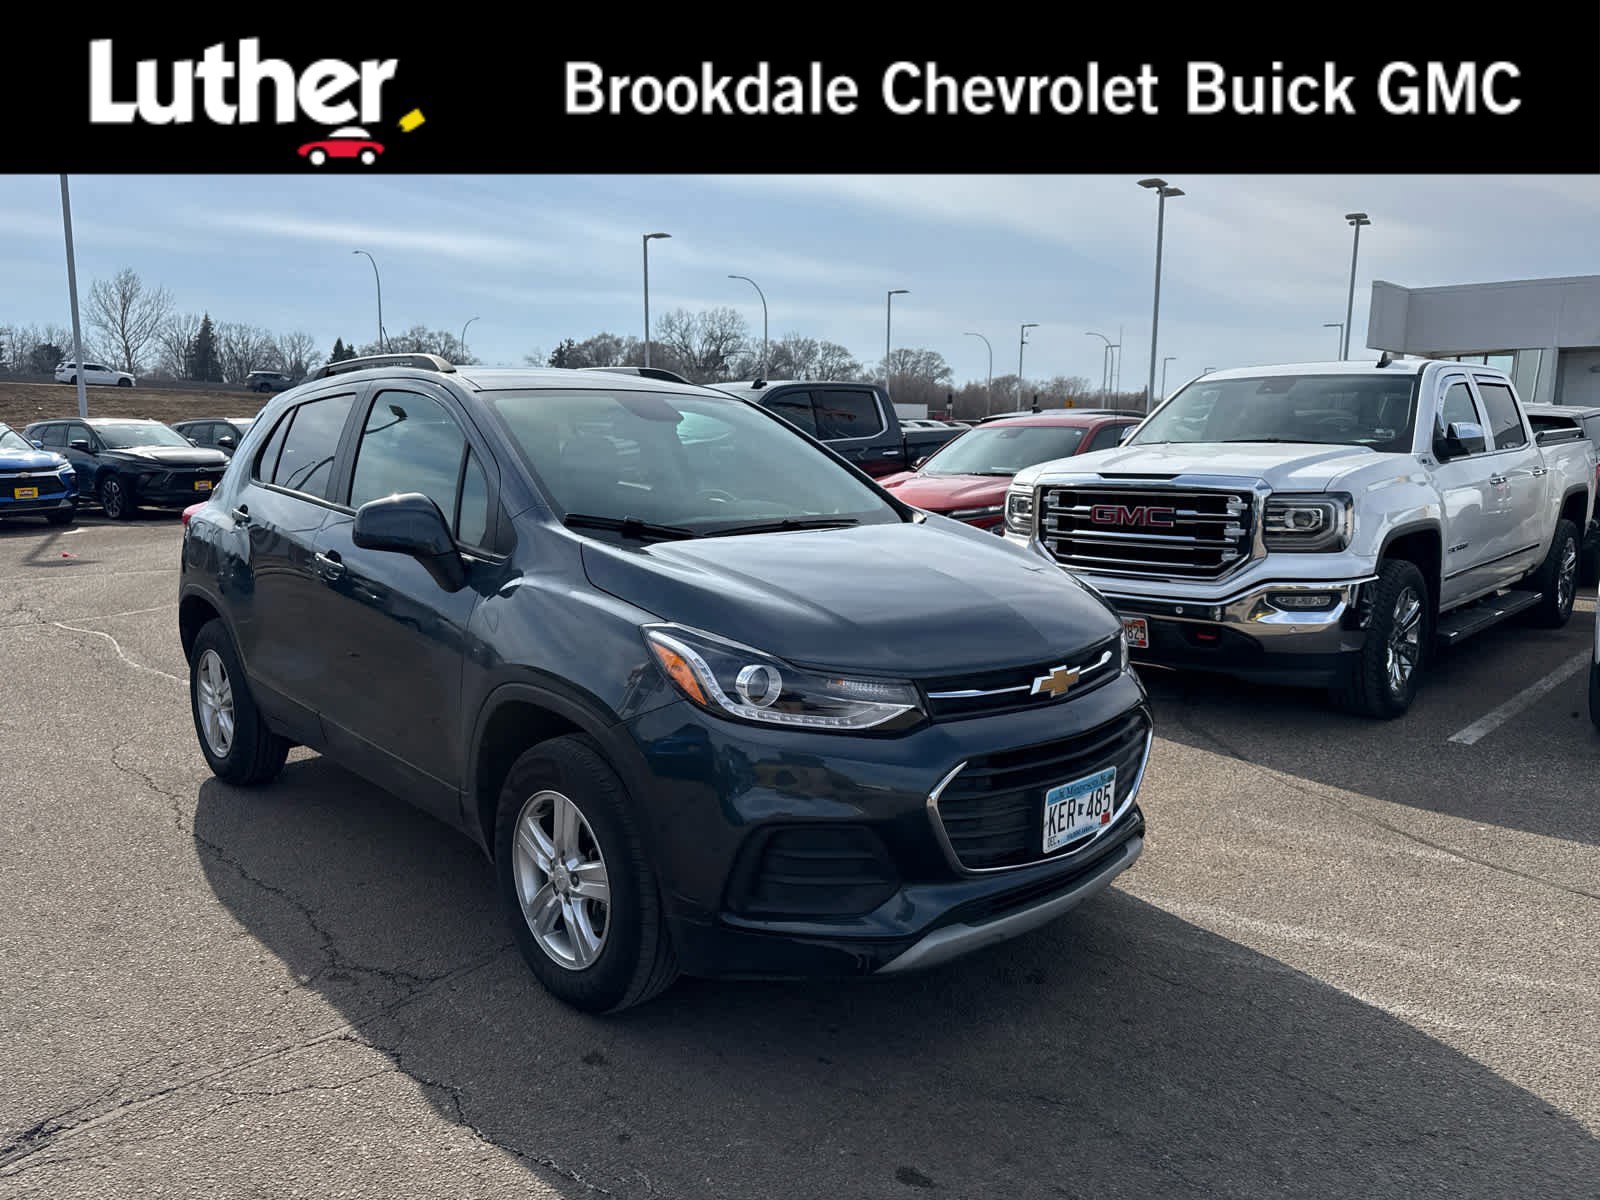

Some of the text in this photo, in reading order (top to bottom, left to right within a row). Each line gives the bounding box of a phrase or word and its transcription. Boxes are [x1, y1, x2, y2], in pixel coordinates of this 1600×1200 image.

[1090, 504, 1175, 527] GMC
[1048, 784, 1111, 836] KER 485
